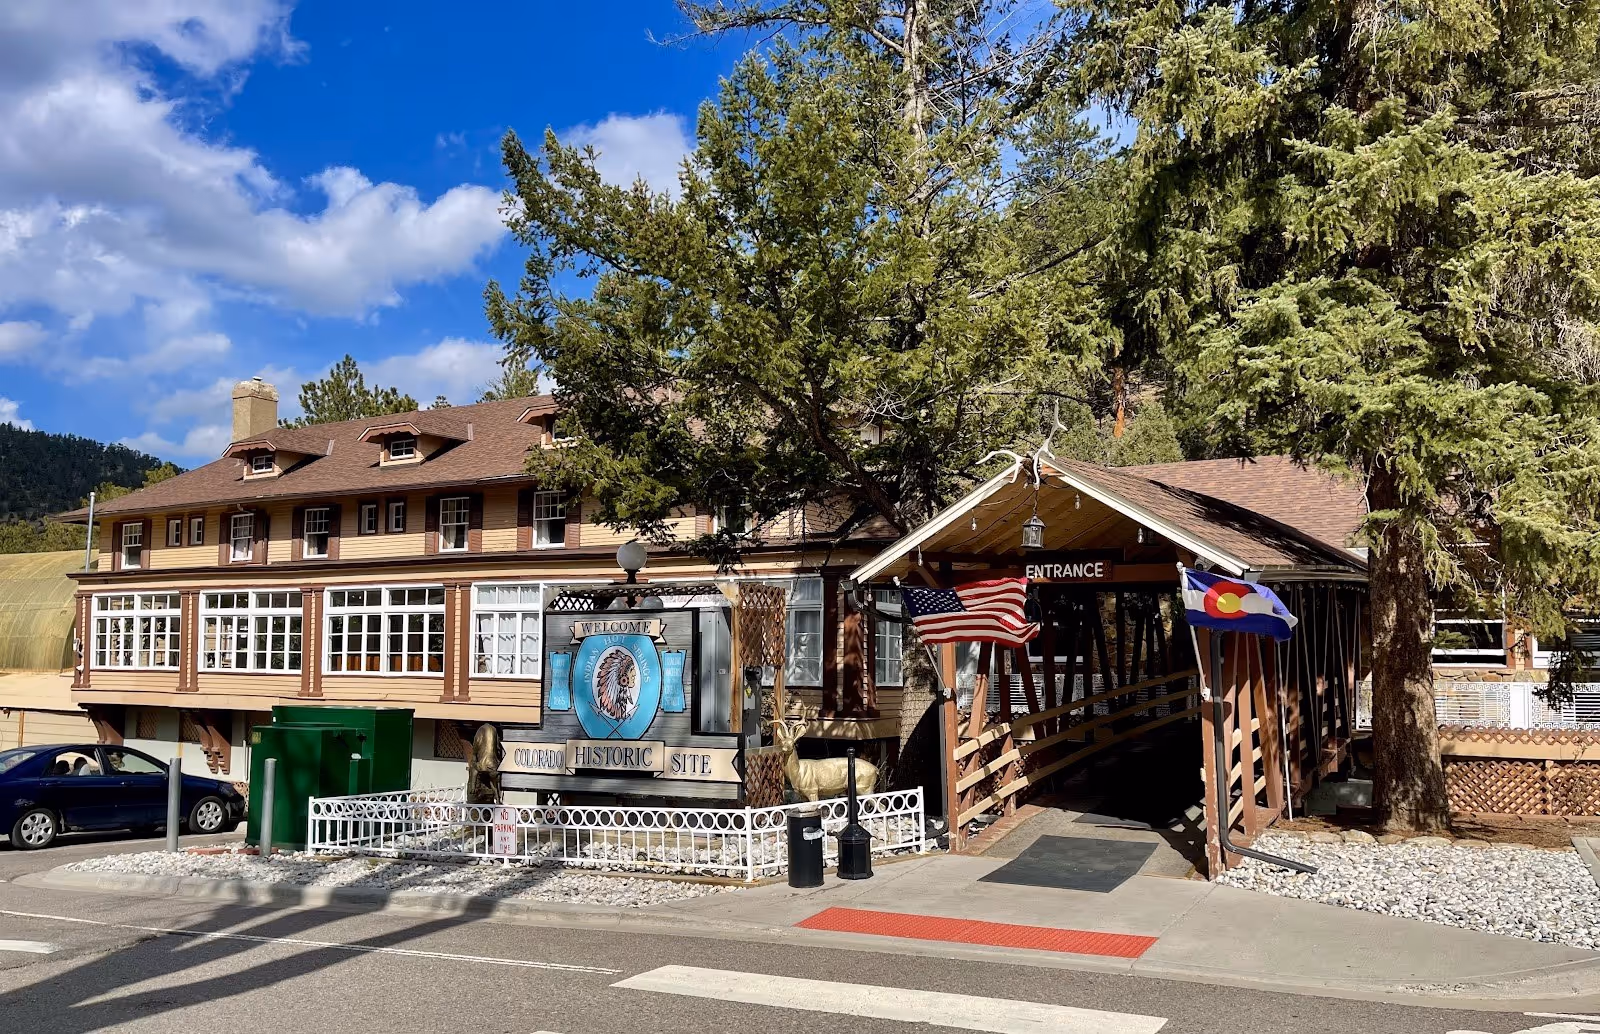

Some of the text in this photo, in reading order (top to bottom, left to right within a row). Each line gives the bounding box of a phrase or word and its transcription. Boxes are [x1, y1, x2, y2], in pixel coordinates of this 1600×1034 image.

[1025, 562, 1104, 579] ENTRANCE
[580, 621, 652, 634] WELCOME
[584, 635, 651, 683] INDIAN HOT SPRINGS
[514, 746, 713, 777] COLORADO HISTORIC SITE
[500, 811, 508, 821] NO
[495, 824, 515, 833] PARKING
